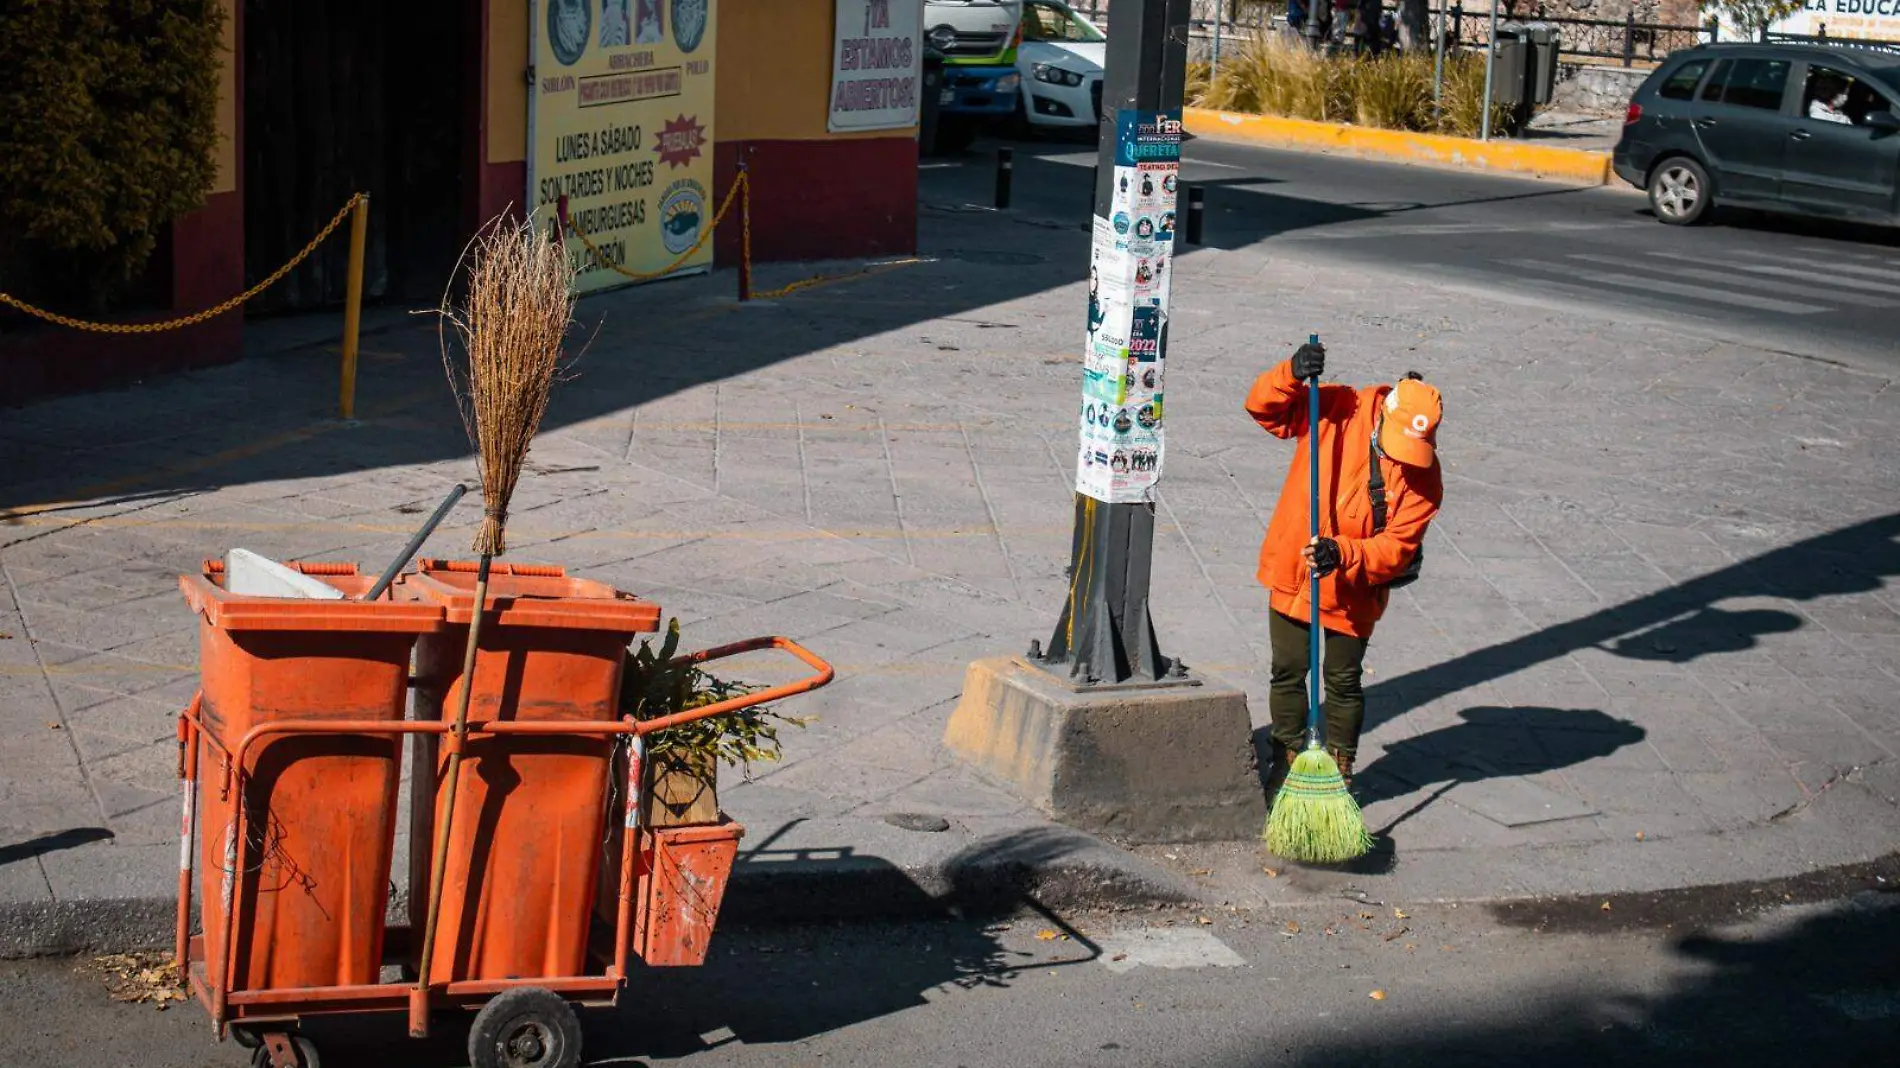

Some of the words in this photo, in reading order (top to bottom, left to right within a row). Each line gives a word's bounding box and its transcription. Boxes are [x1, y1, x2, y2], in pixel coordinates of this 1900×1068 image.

[1805, 0, 1827, 11] LA
[840, 37, 913, 70] ESTAMOS
[834, 77, 916, 111] ABIERTOS!
[556, 133, 590, 162] LUNES
[589, 133, 599, 156] A
[600, 123, 641, 155] SÁBADO
[540, 176, 563, 205] SON
[565, 169, 604, 200] TARDES
[606, 168, 615, 192] Y
[615, 159, 654, 191] NOCHES
[565, 199, 646, 238] MBURGUESAS
[1129, 338, 1156, 351] 2022
